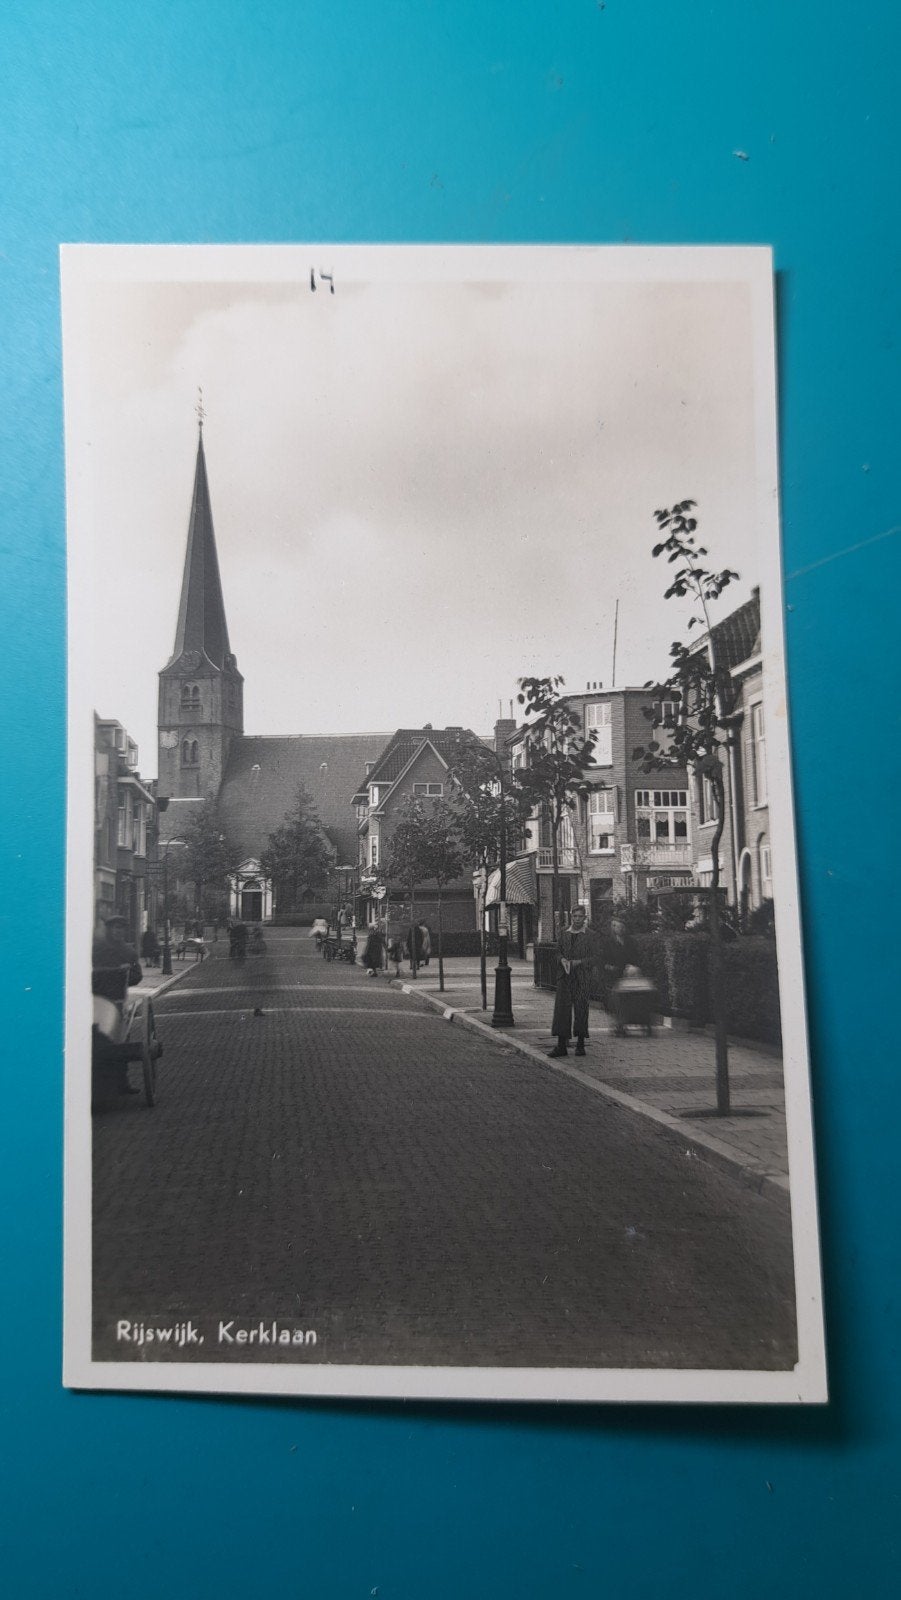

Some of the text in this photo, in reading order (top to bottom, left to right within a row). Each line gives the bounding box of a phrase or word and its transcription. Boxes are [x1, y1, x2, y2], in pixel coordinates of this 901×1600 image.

[310, 268, 335, 295] 14
[116, 1319, 318, 1347] Rijswijk, Kerklaan
